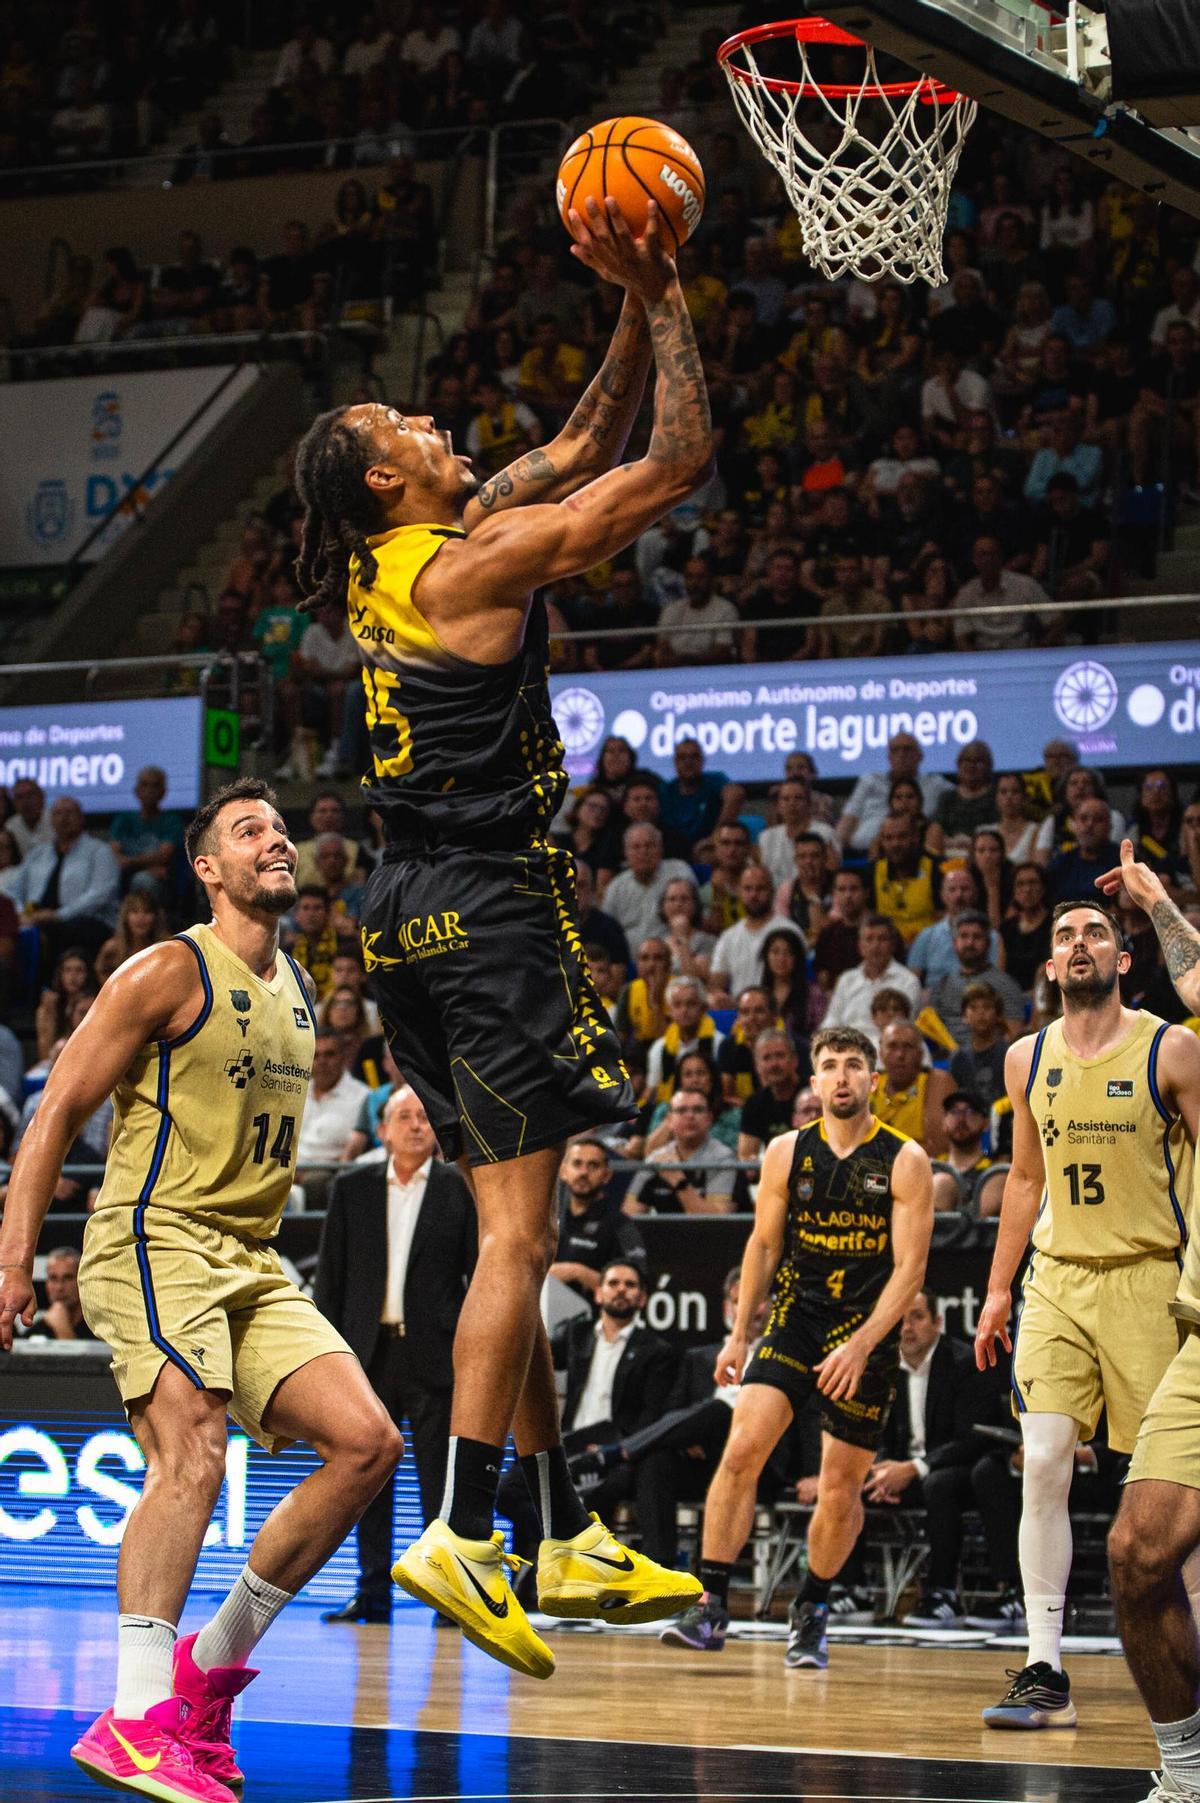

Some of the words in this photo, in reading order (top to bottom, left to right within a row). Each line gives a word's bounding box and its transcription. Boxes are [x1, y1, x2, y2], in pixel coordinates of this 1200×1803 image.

[651, 691, 752, 714] Organismo
[755, 684, 857, 704] Autónomo
[860, 680, 886, 700] de
[889, 679, 978, 702] Deportes
[49, 724, 124, 746] Deportes
[805, 704, 978, 761] lagunero
[449, 939, 469, 951] Car
[261, 1074, 301, 1095] Sanitària
[1067, 1120, 1137, 1133] Assistència
[1067, 1132, 1116, 1144] Sanitària
[253, 1112, 295, 1168] 14
[1063, 1163, 1105, 1205] 13
[827, 1269, 846, 1299] 4
